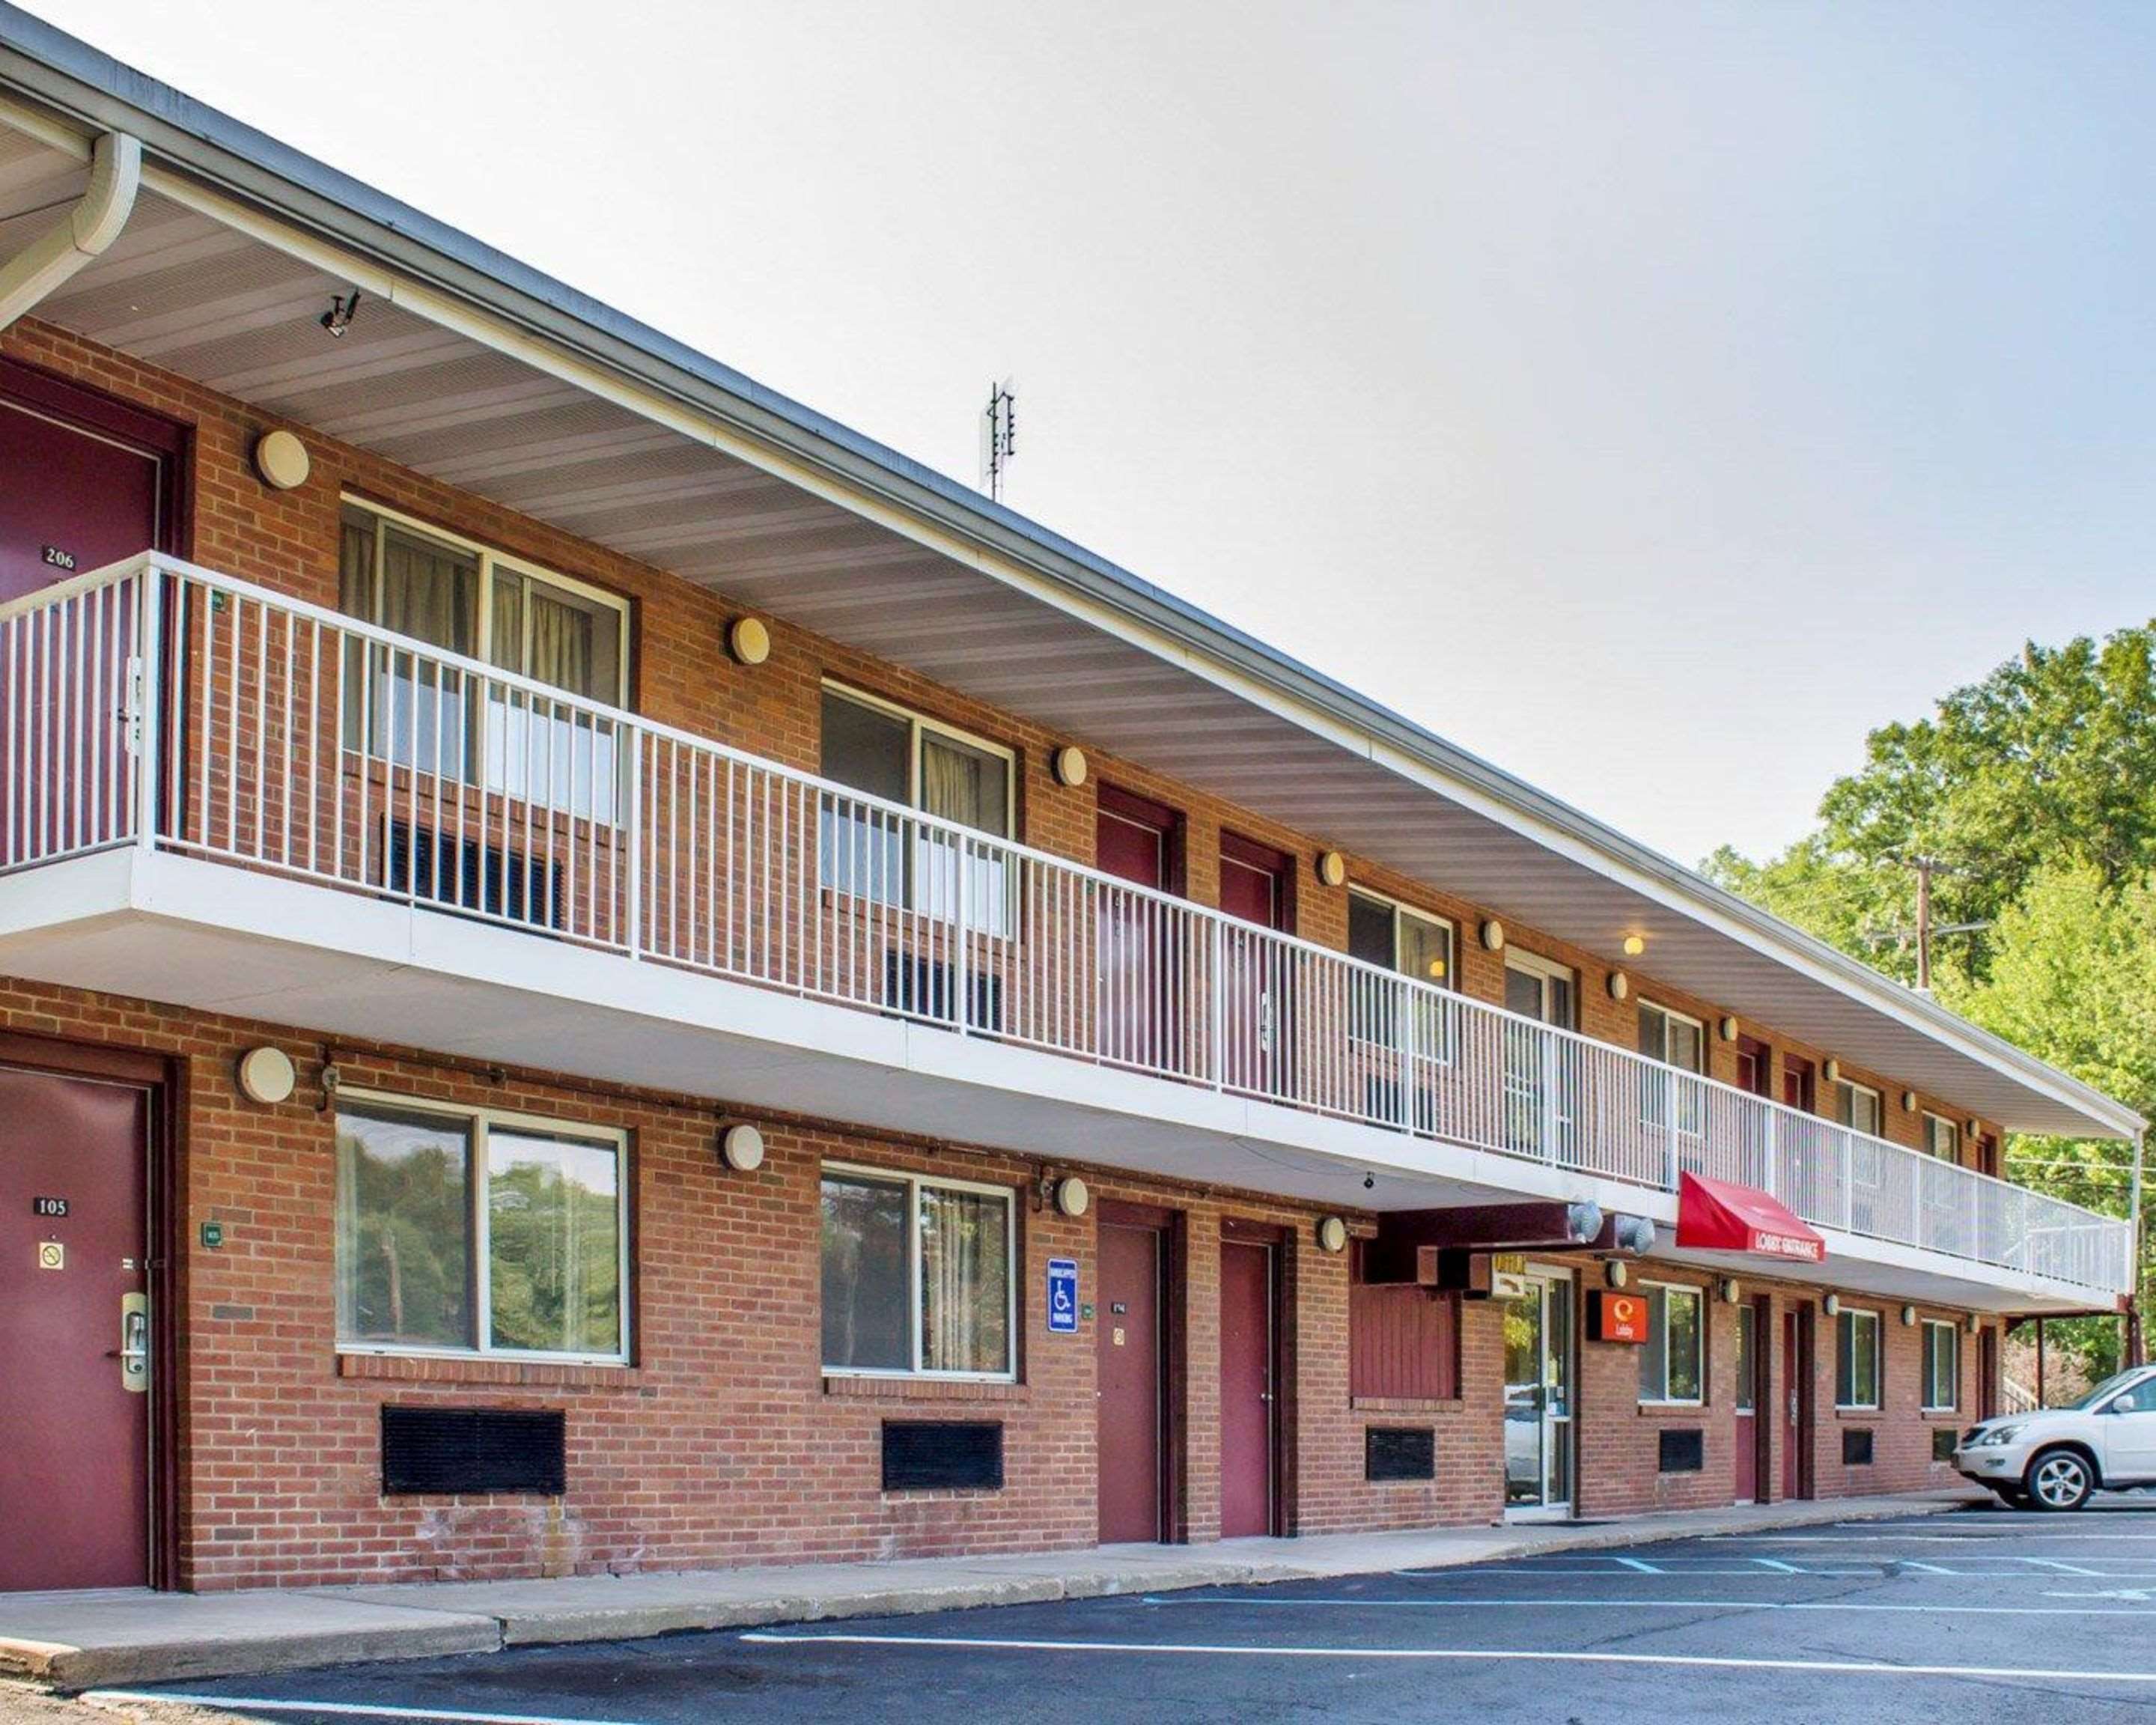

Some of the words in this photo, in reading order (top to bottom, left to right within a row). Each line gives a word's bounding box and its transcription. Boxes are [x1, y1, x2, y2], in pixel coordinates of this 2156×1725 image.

[47, 547, 74, 568] 206
[40, 1199, 67, 1215] 105
[1755, 1231, 1782, 1253] LOBBY
[1616, 1323, 1633, 1339] Lobby
